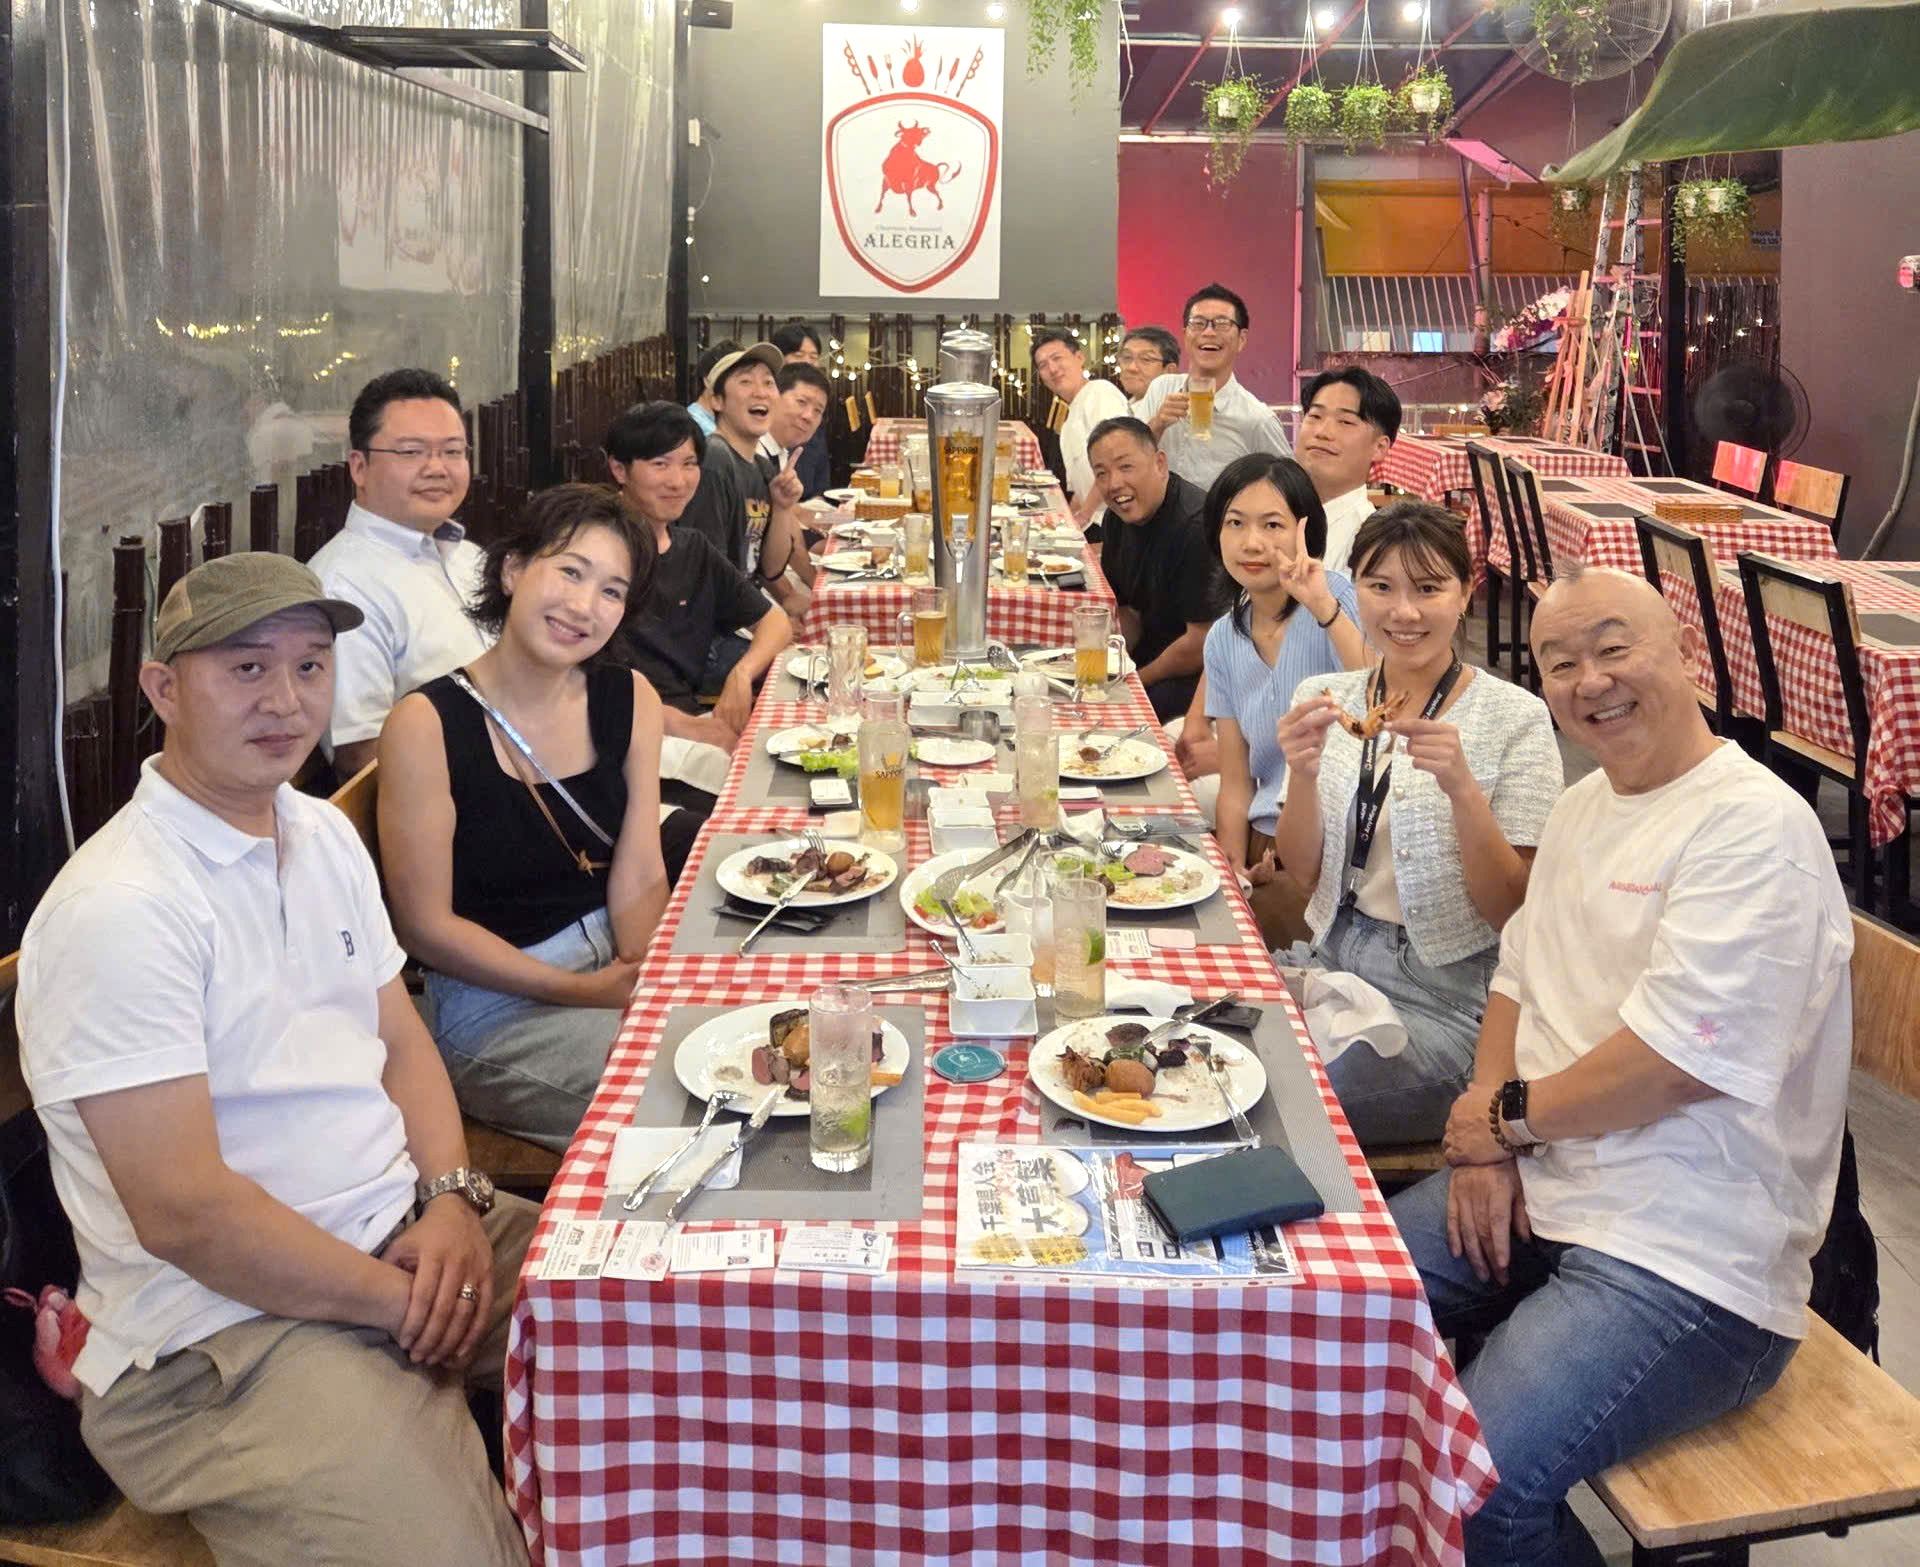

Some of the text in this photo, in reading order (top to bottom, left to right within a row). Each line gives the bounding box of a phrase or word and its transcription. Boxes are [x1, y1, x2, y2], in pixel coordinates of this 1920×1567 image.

[864, 233, 955, 249] ALEGRIA
[1426, 692, 1443, 717] AnyMind
[1366, 740, 1374, 763] AnyMind
[1365, 804, 1377, 833] AnyMind
[340, 930, 355, 957] B
[972, 1161, 1006, 1231] 千葉県人会
